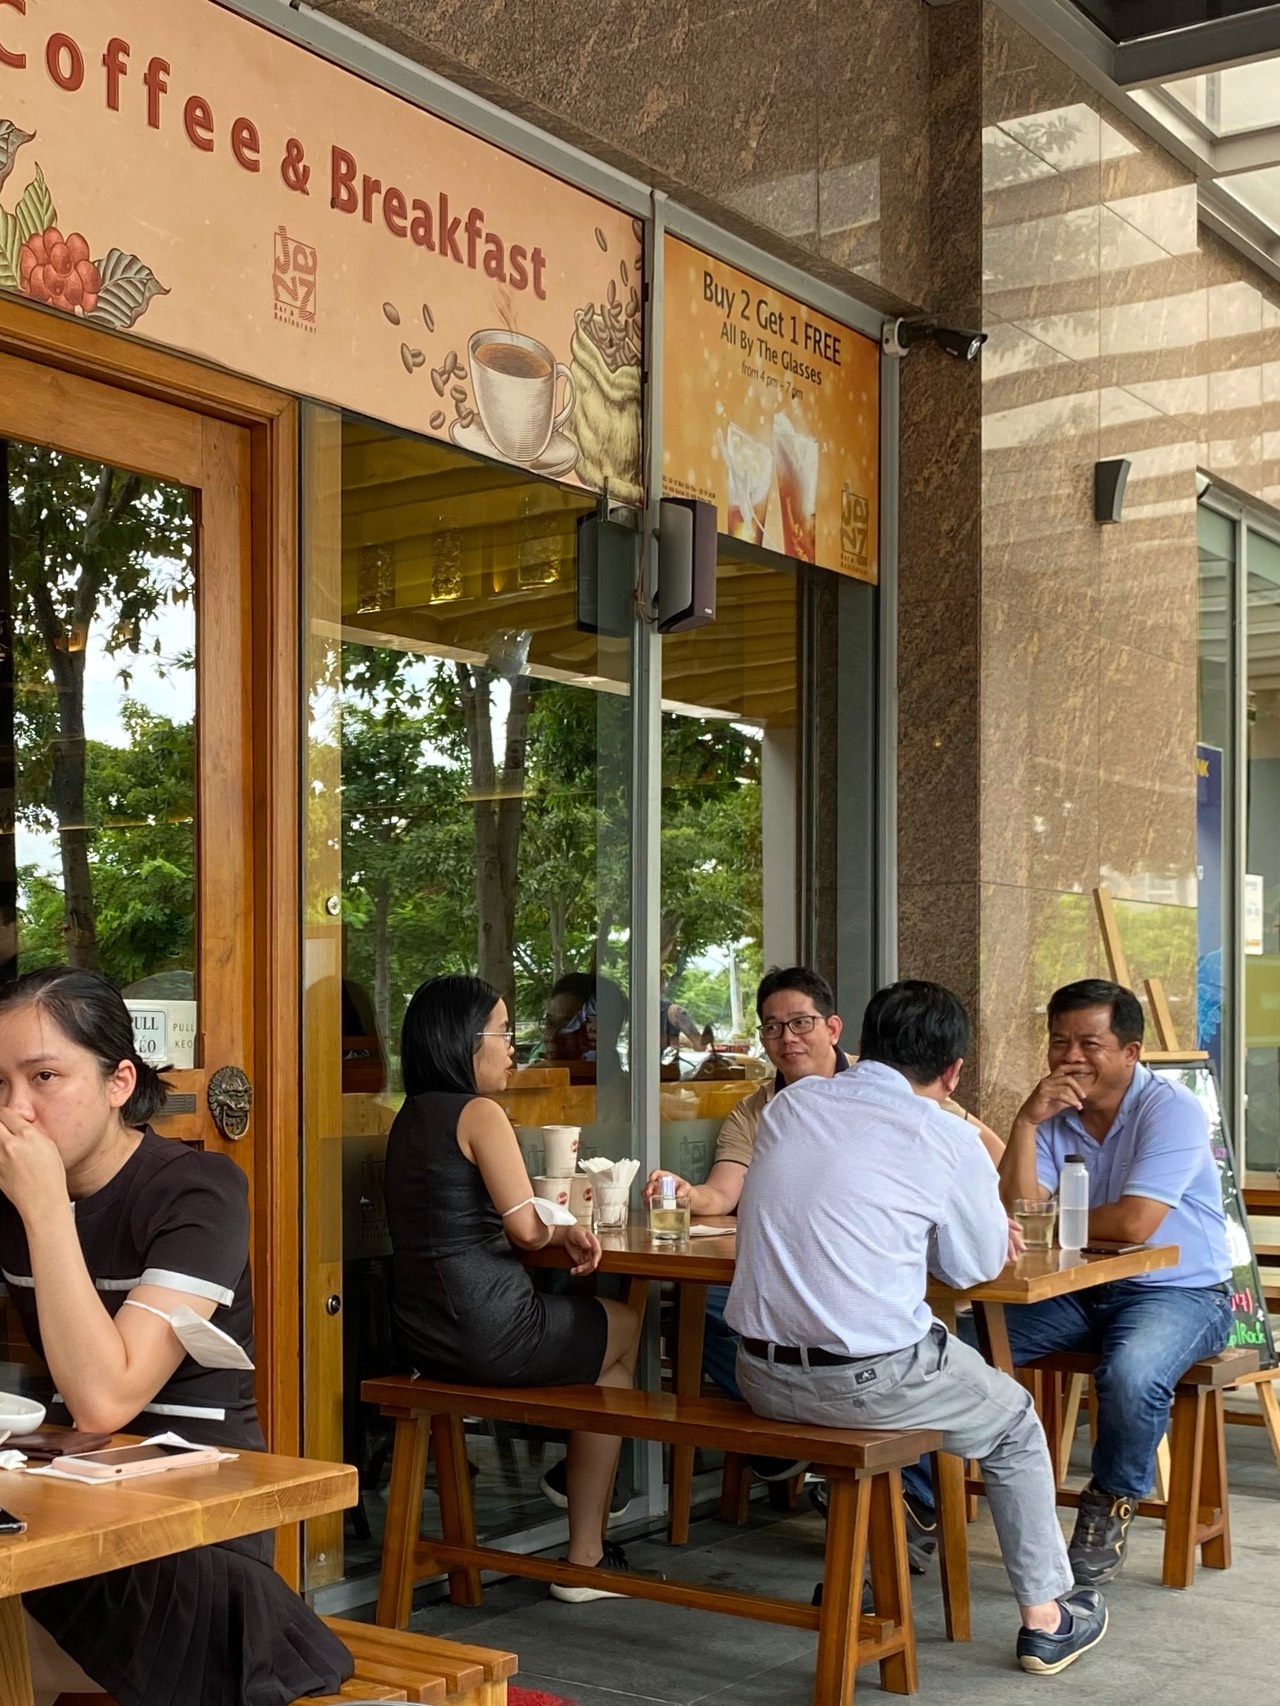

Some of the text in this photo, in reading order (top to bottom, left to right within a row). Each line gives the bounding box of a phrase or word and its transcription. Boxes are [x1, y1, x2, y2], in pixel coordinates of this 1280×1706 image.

[281, 137, 311, 196] &
[330, 144, 547, 301] Breakfast
[703, 270, 841, 366] Buy 2 Get 1 FREE
[721, 321, 822, 386] All By The Glasses
[741, 360, 759, 380] from
[133, 1016, 159, 1031] ULL
